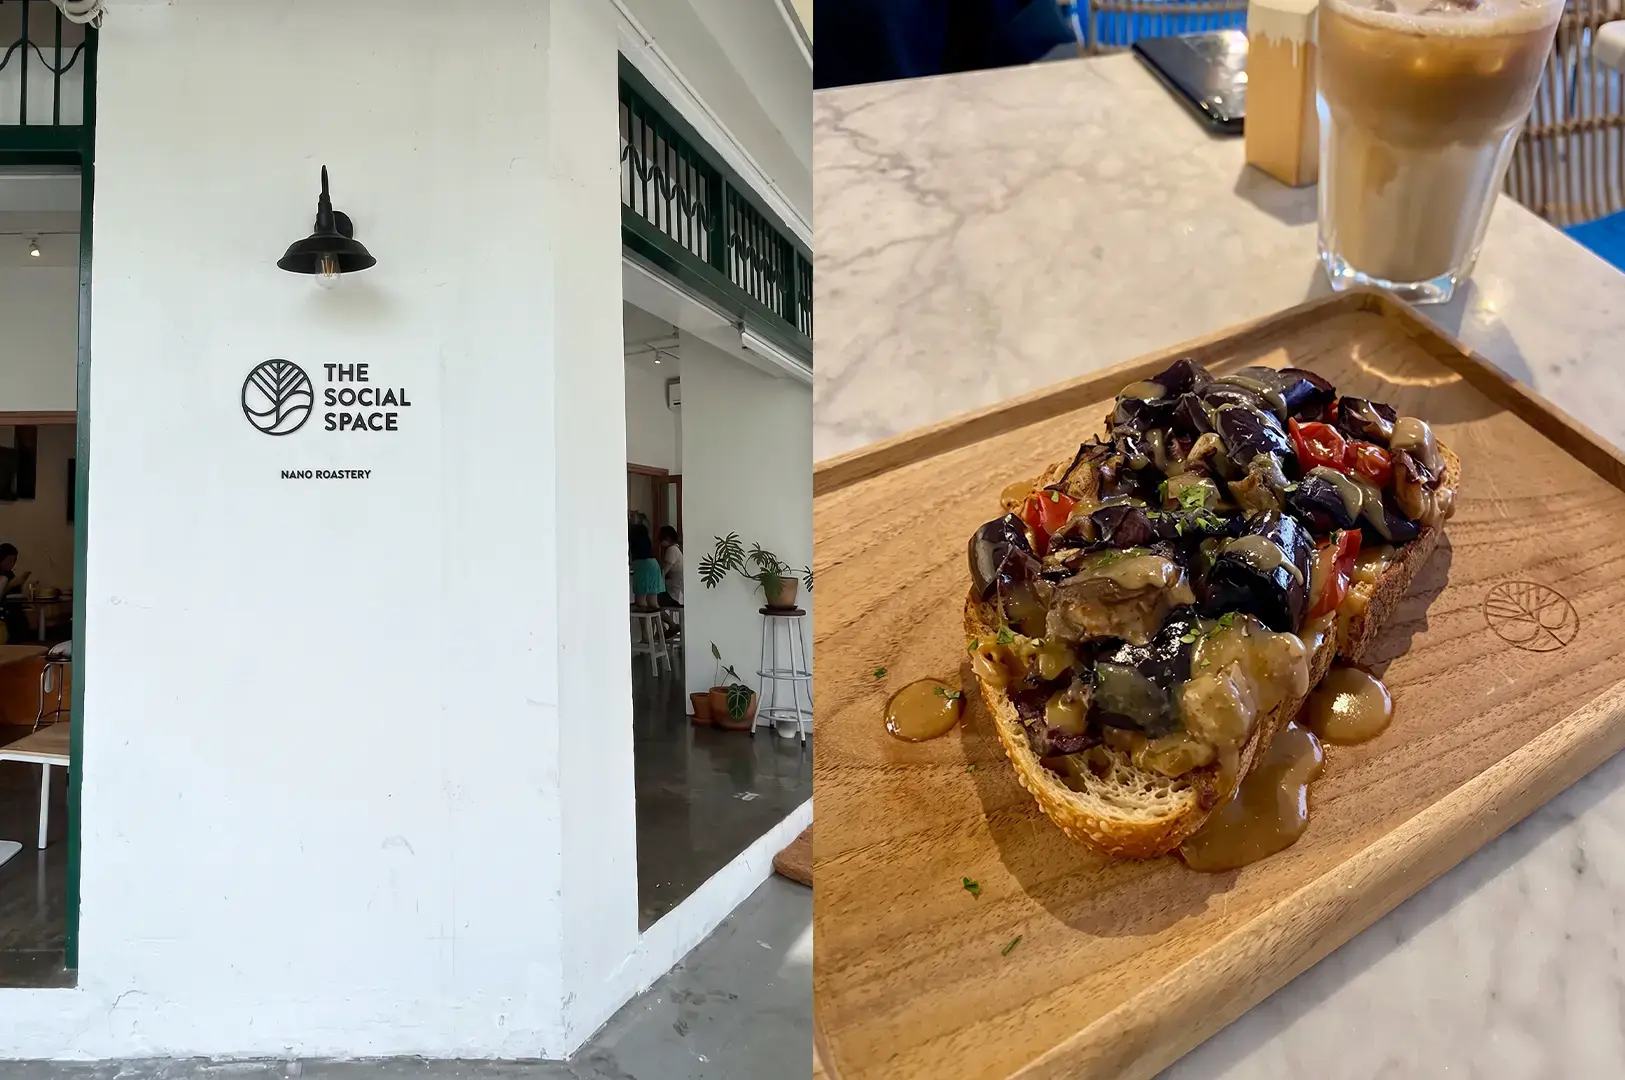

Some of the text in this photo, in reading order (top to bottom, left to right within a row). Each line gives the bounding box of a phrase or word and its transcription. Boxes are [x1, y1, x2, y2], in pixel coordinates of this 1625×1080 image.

[323, 363, 369, 382] THE
[324, 387, 412, 407] SOCIAL
[324, 412, 398, 432] SPACE
[281, 469, 372, 480] NANO ROASTERY
